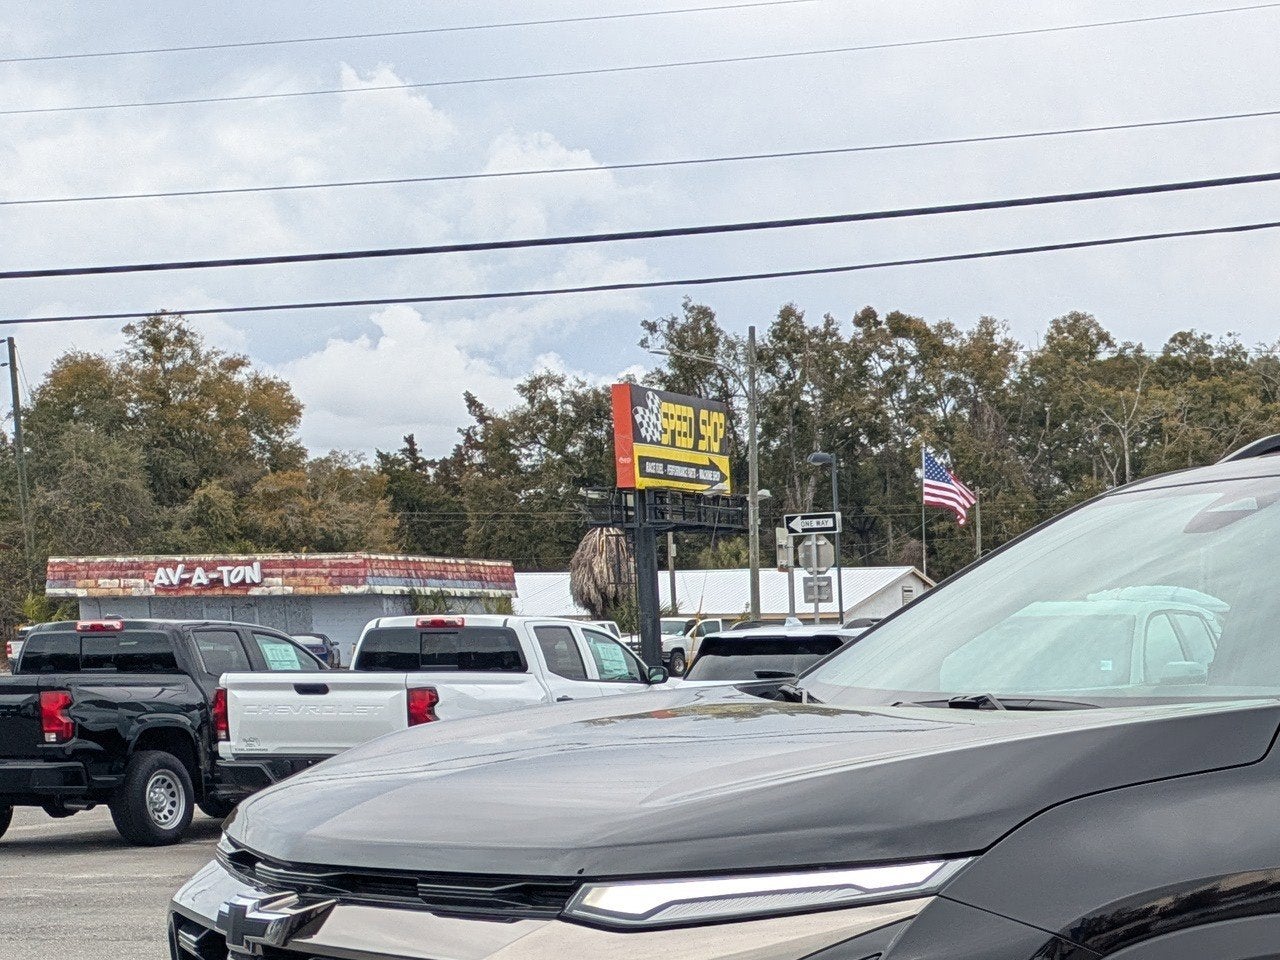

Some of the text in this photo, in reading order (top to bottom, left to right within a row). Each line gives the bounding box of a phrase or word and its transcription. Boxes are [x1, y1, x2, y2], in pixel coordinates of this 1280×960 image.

[661, 401, 725, 453] SPEED SHOP
[801, 519, 829, 528] ONE WAY
[153, 561, 262, 588] AV-A-TON
[242, 704, 385, 716] CHEVROLET
